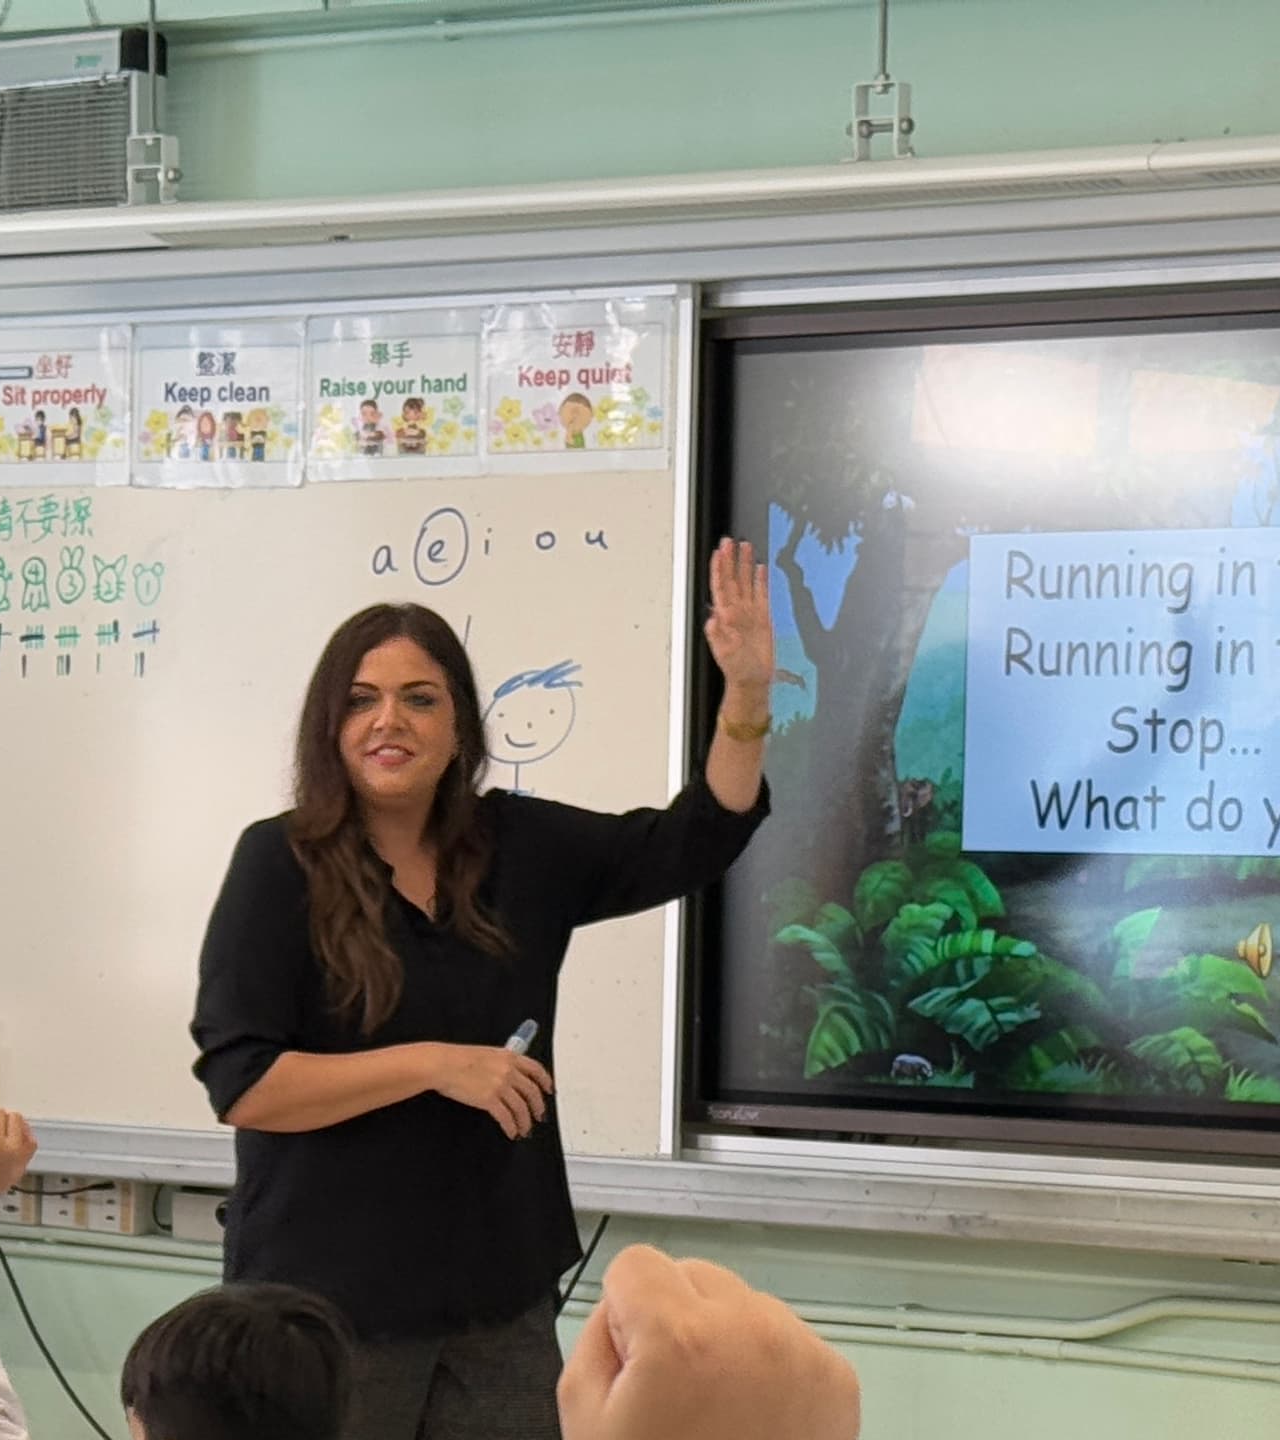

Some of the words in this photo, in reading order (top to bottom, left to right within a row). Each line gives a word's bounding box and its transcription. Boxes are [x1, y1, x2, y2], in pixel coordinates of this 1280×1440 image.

[369, 341, 413, 369] 舉手
[552, 330, 596, 359] 安靜
[36, 354, 73, 379] 坐好
[518, 366, 570, 389] Keep
[2, 385, 25, 406] Sit
[32, 384, 107, 408] properly
[164, 382, 212, 407] Keep
[219, 381, 271, 403] clean
[320, 377, 366, 398] Raise
[373, 380, 415, 401] your
[421, 373, 467, 393] hand
[372, 545, 398, 575] a
[427, 539, 447, 563] e
[483, 527, 493, 555] i
[535, 531, 556, 550] o
[584, 529, 608, 550] u
[27, 563, 40, 580] 4
[65, 574, 78, 598] 3
[1004, 548, 1195, 615] Running
[1216, 547, 1258, 597] in
[1004, 626, 1194, 693] Running
[1215, 625, 1255, 675] in
[1106, 705, 1263, 770] Stop...
[1031, 778, 1166, 832] What
[1185, 780, 1244, 833] do
